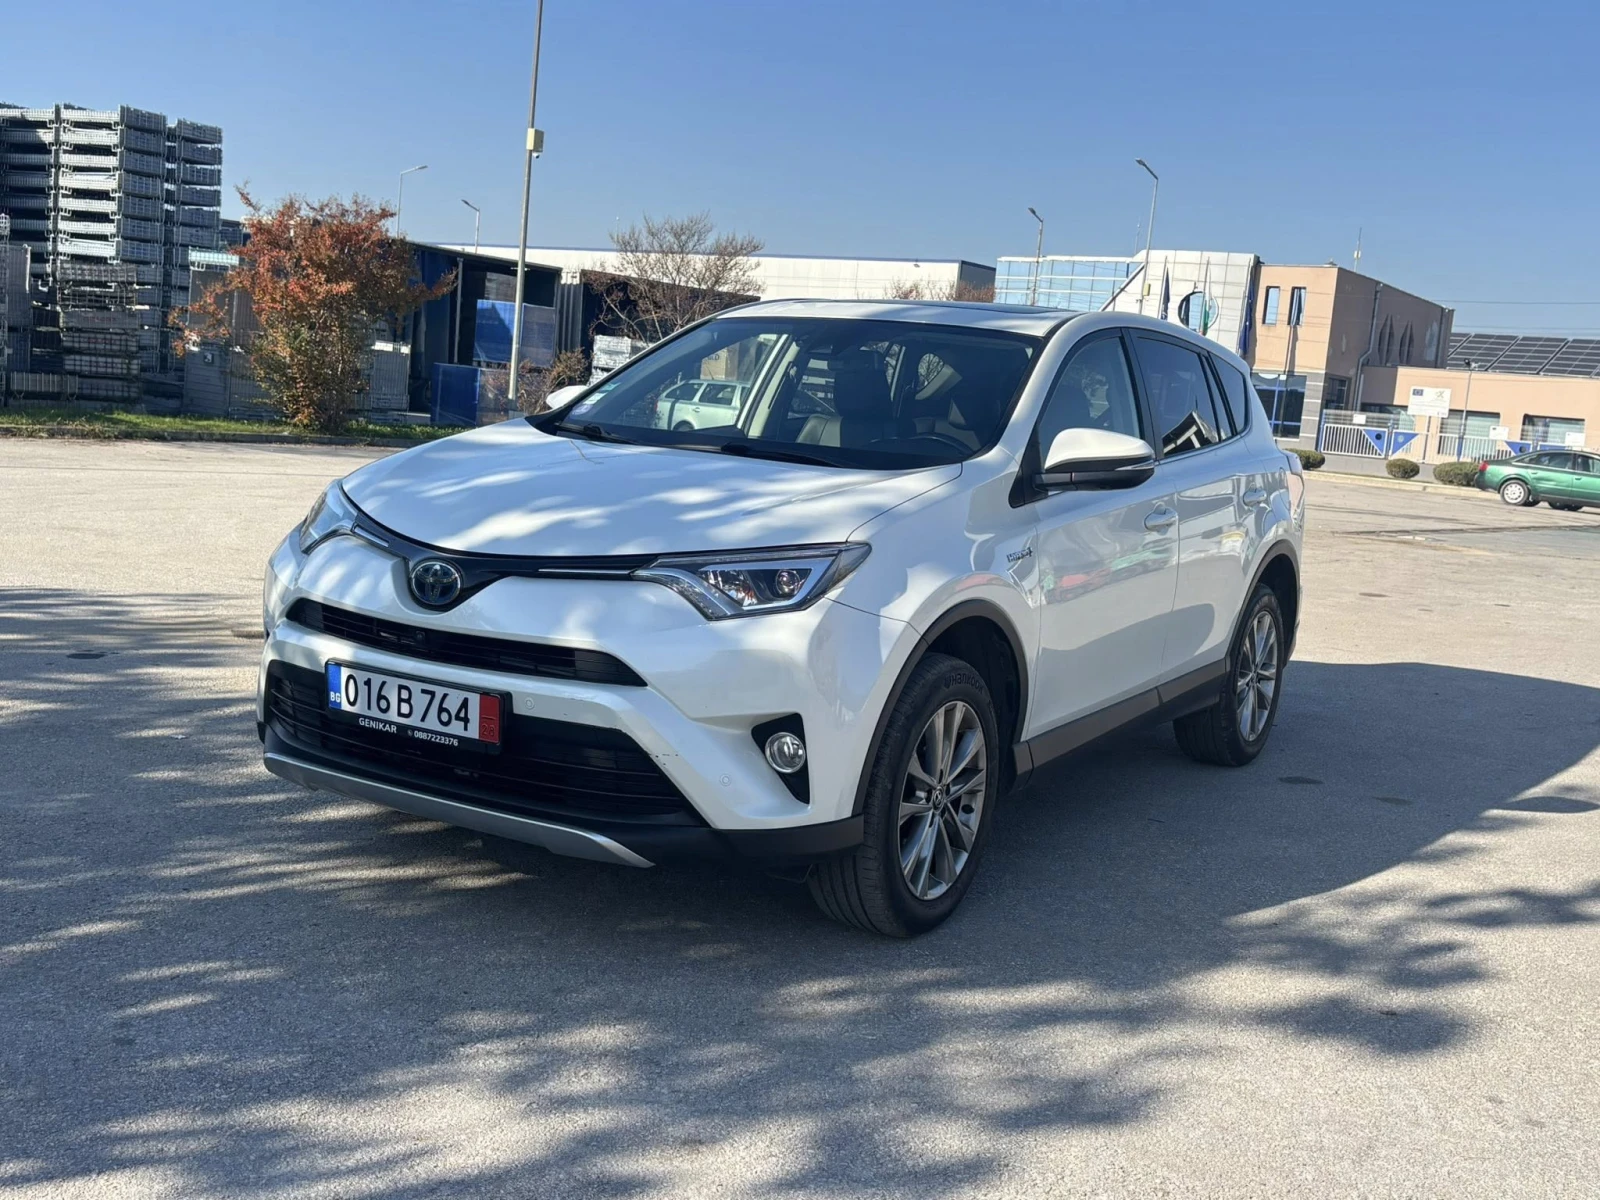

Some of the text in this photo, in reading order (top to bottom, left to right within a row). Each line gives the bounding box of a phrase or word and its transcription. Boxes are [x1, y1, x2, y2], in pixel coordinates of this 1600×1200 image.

[330, 691, 341, 703] BG
[345, 674, 470, 731] 016B764
[358, 717, 459, 746] GENIKAR 0887223376
